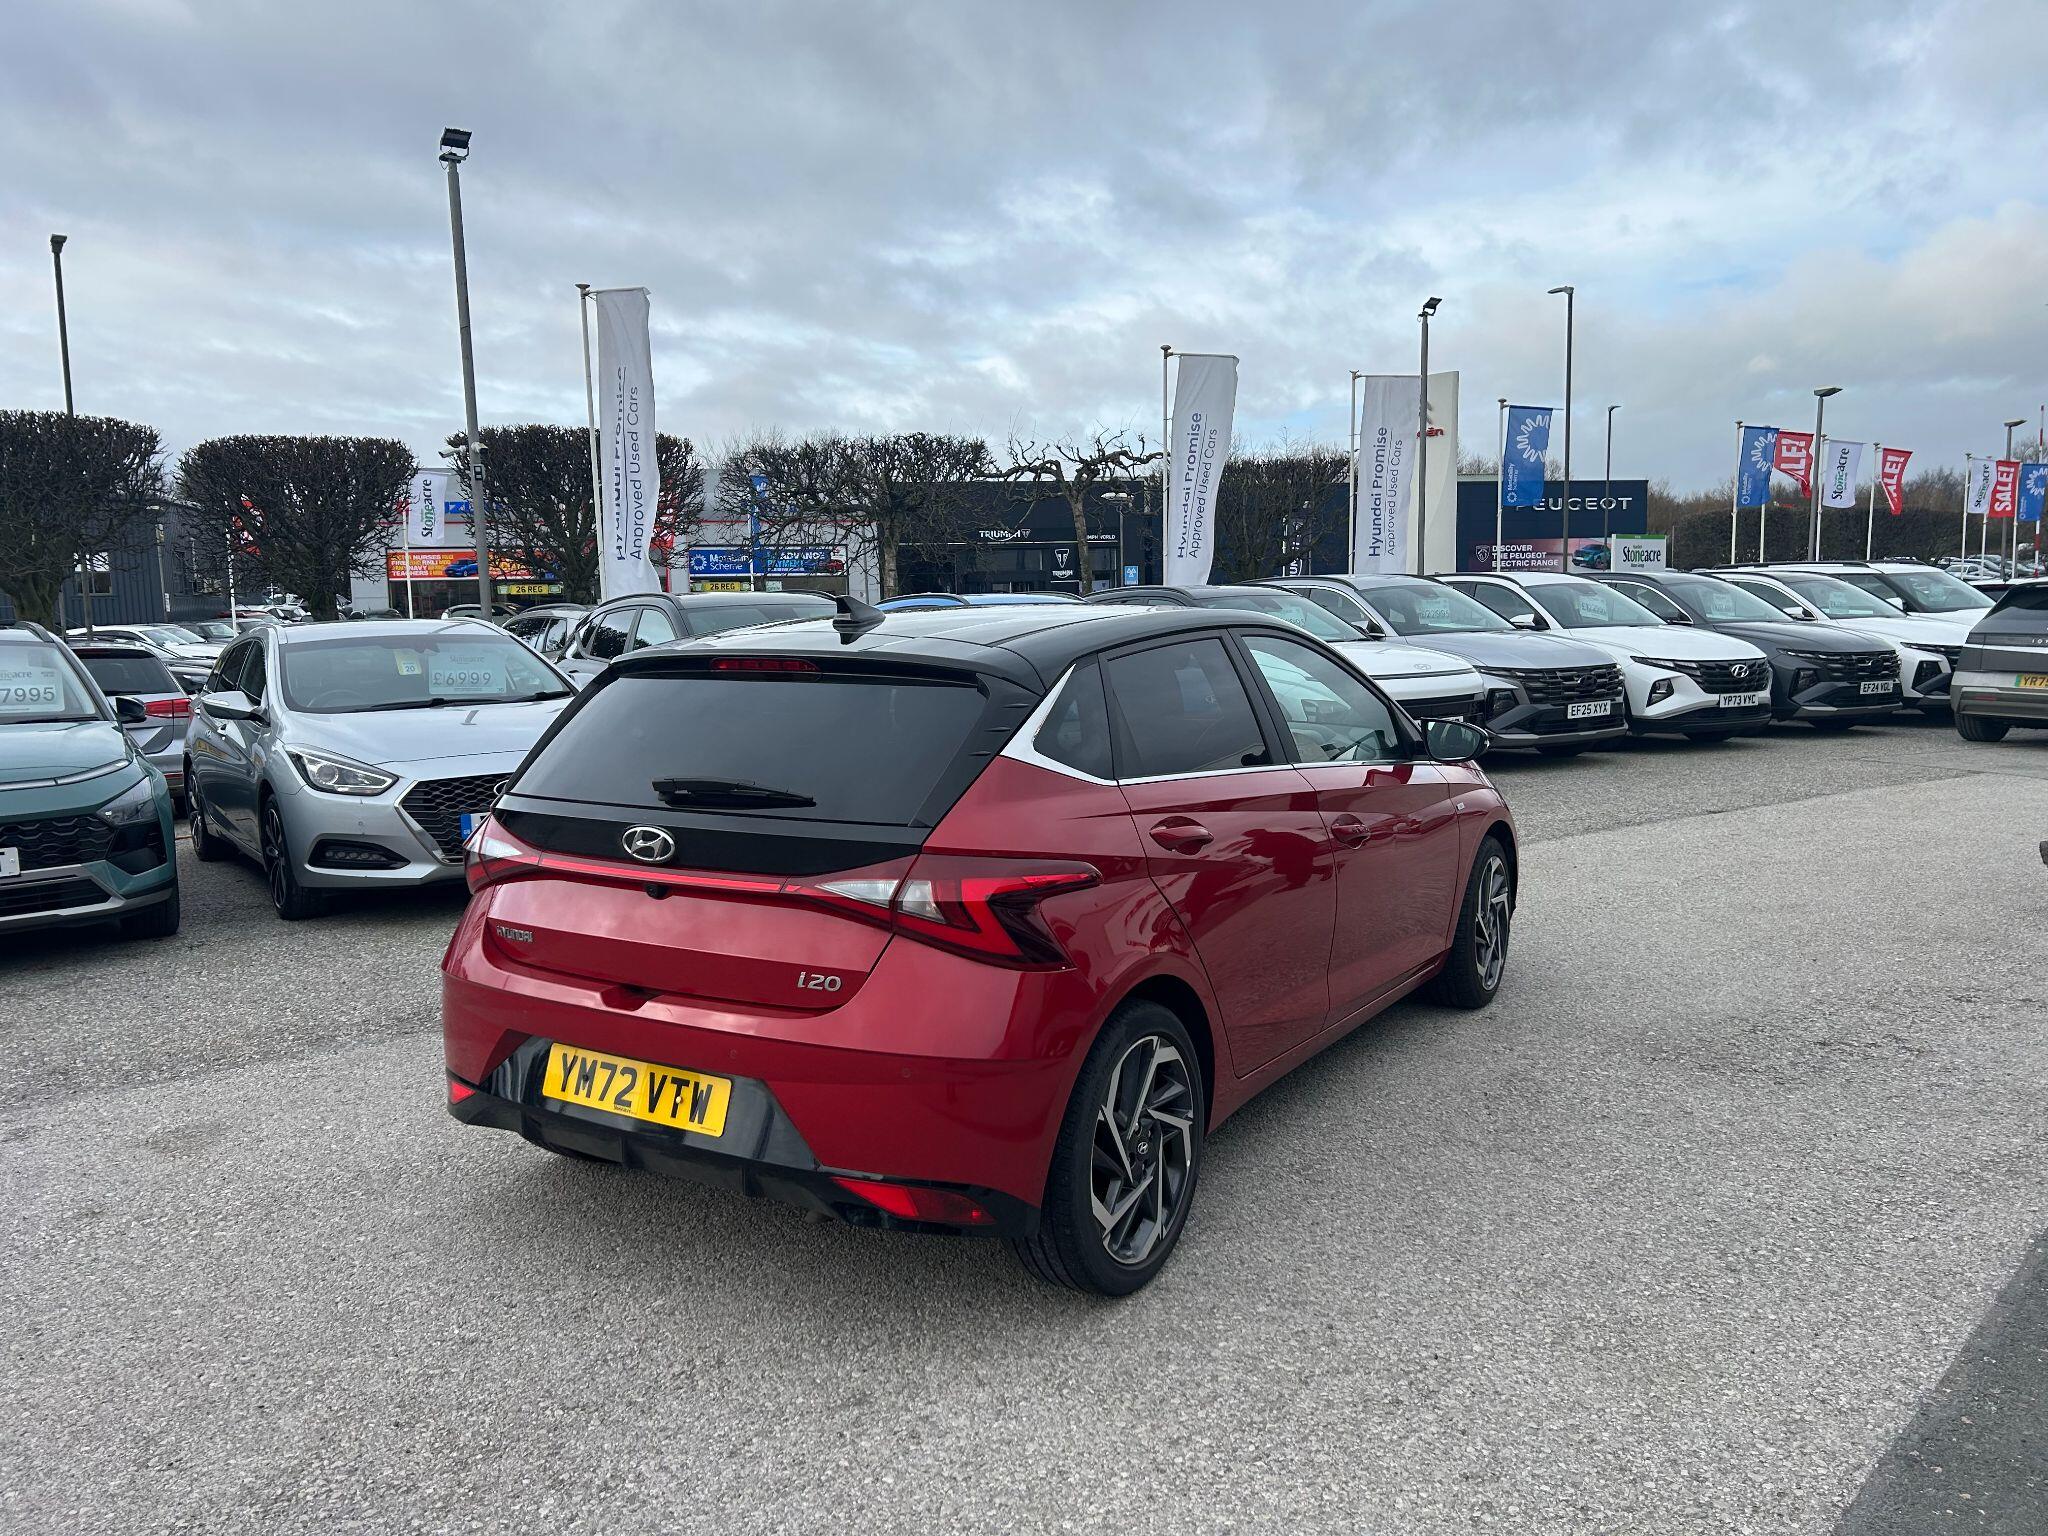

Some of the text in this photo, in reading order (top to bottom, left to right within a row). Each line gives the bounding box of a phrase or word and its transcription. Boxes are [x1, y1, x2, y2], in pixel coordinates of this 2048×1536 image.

[627, 386, 639, 426] Cars
[629, 431, 641, 474] Used
[1177, 412, 1202, 558] Hyundai Promise
[1189, 428, 1218, 559] Approved Used Cars
[1368, 427, 1388, 557] Hyundai Promise
[1831, 448, 1850, 500] Stoneacre
[1886, 455, 1905, 498] ALE!
[1994, 466, 2015, 512] SALE!
[421, 479, 435, 538] Stoneacre
[1387, 439, 1403, 556] Approved Used Cars
[1516, 497, 1633, 511] EUGEOT
[1492, 544, 1533, 552] DSCOVER
[1531, 559, 1559, 567] RANGE
[1622, 546, 1662, 563] Stoneacre
[527, 585, 543, 593] REG
[720, 582, 735, 590] REG
[433, 671, 492, 686] £6999
[1571, 702, 1608, 716] EF25 XYX
[1723, 695, 1742, 706] YP73
[561, 1053, 714, 1125] YM72 VTW
